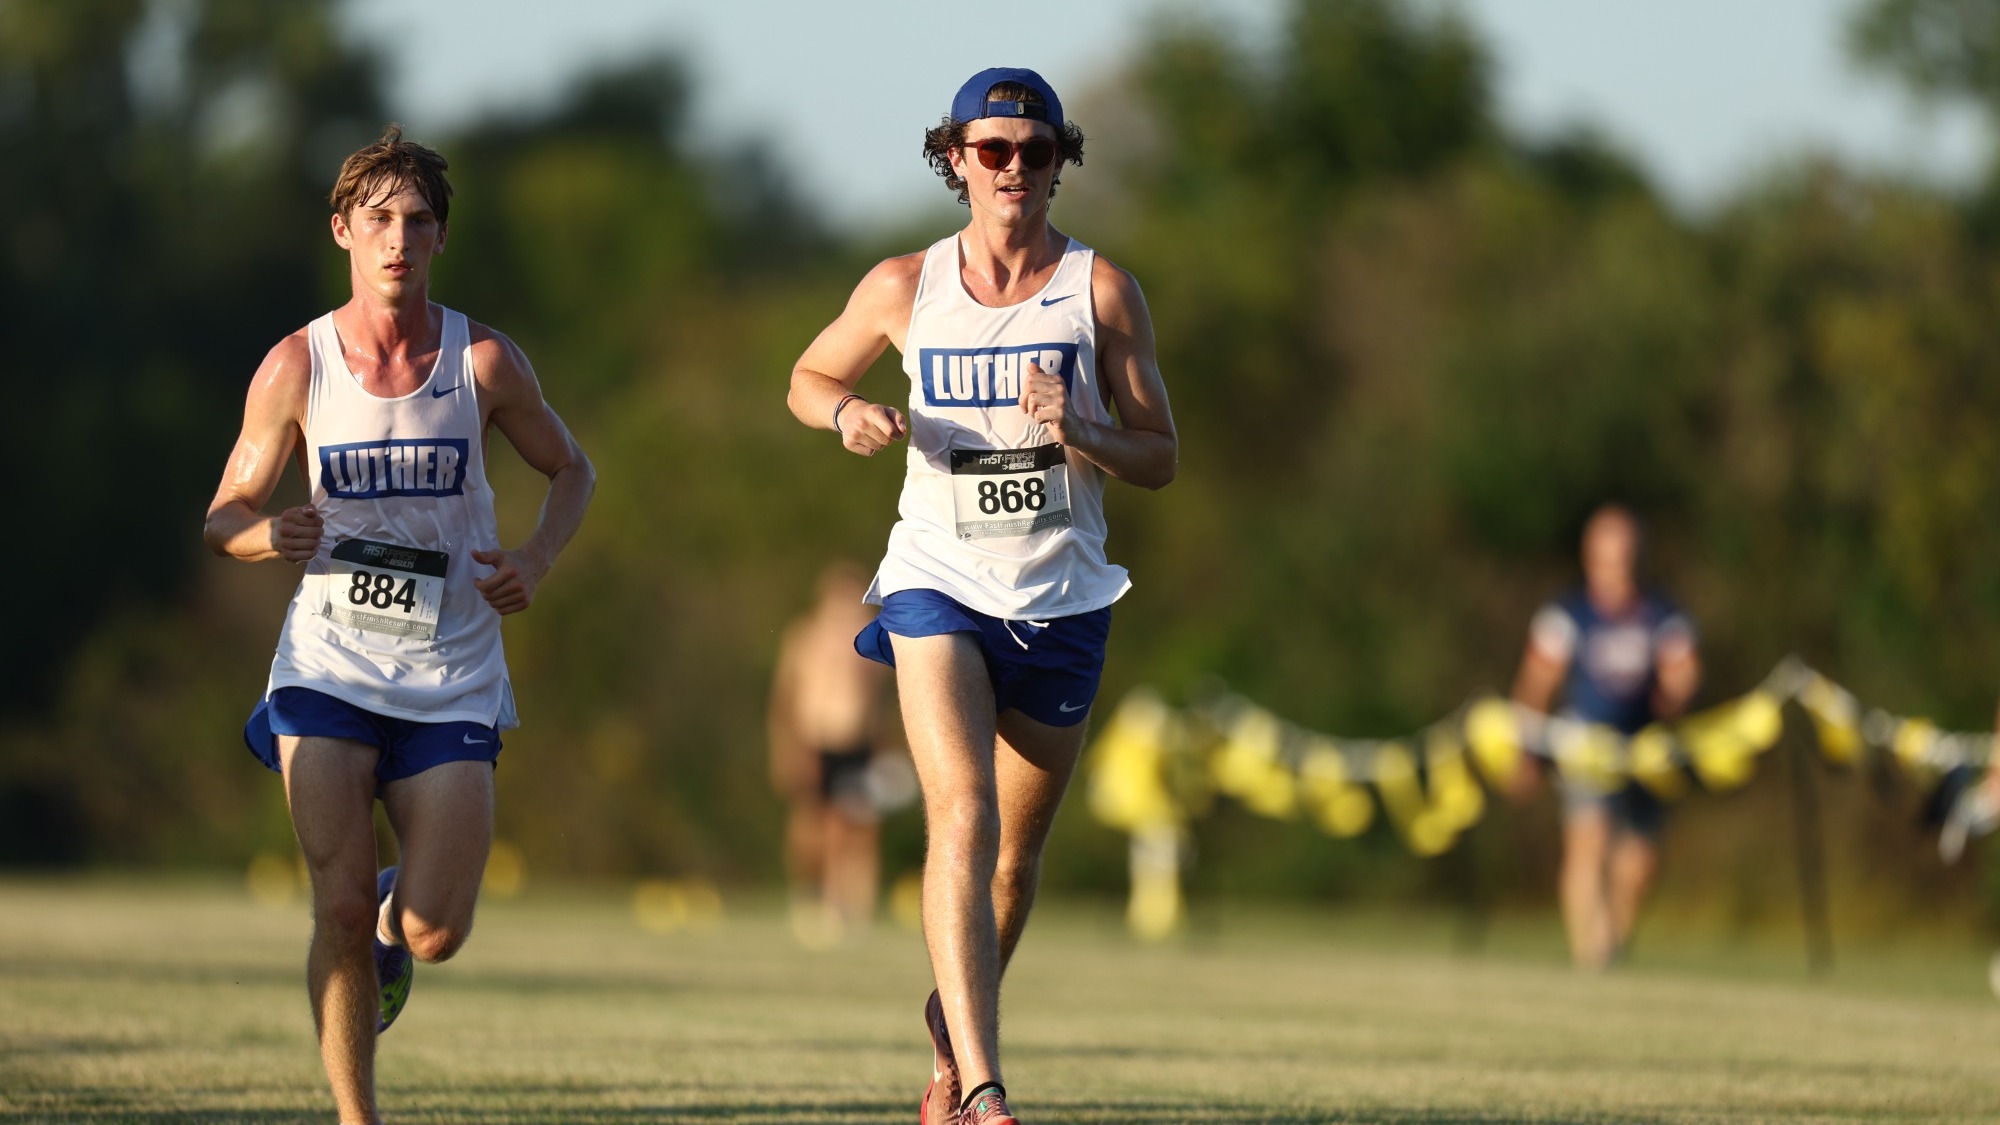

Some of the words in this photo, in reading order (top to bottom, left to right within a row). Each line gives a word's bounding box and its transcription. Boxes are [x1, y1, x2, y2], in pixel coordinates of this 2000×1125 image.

[329, 445, 459, 493] LUTHER
[977, 477, 1047, 515] 868
[362, 544, 386, 557] FAST
[348, 570, 417, 613] 884
